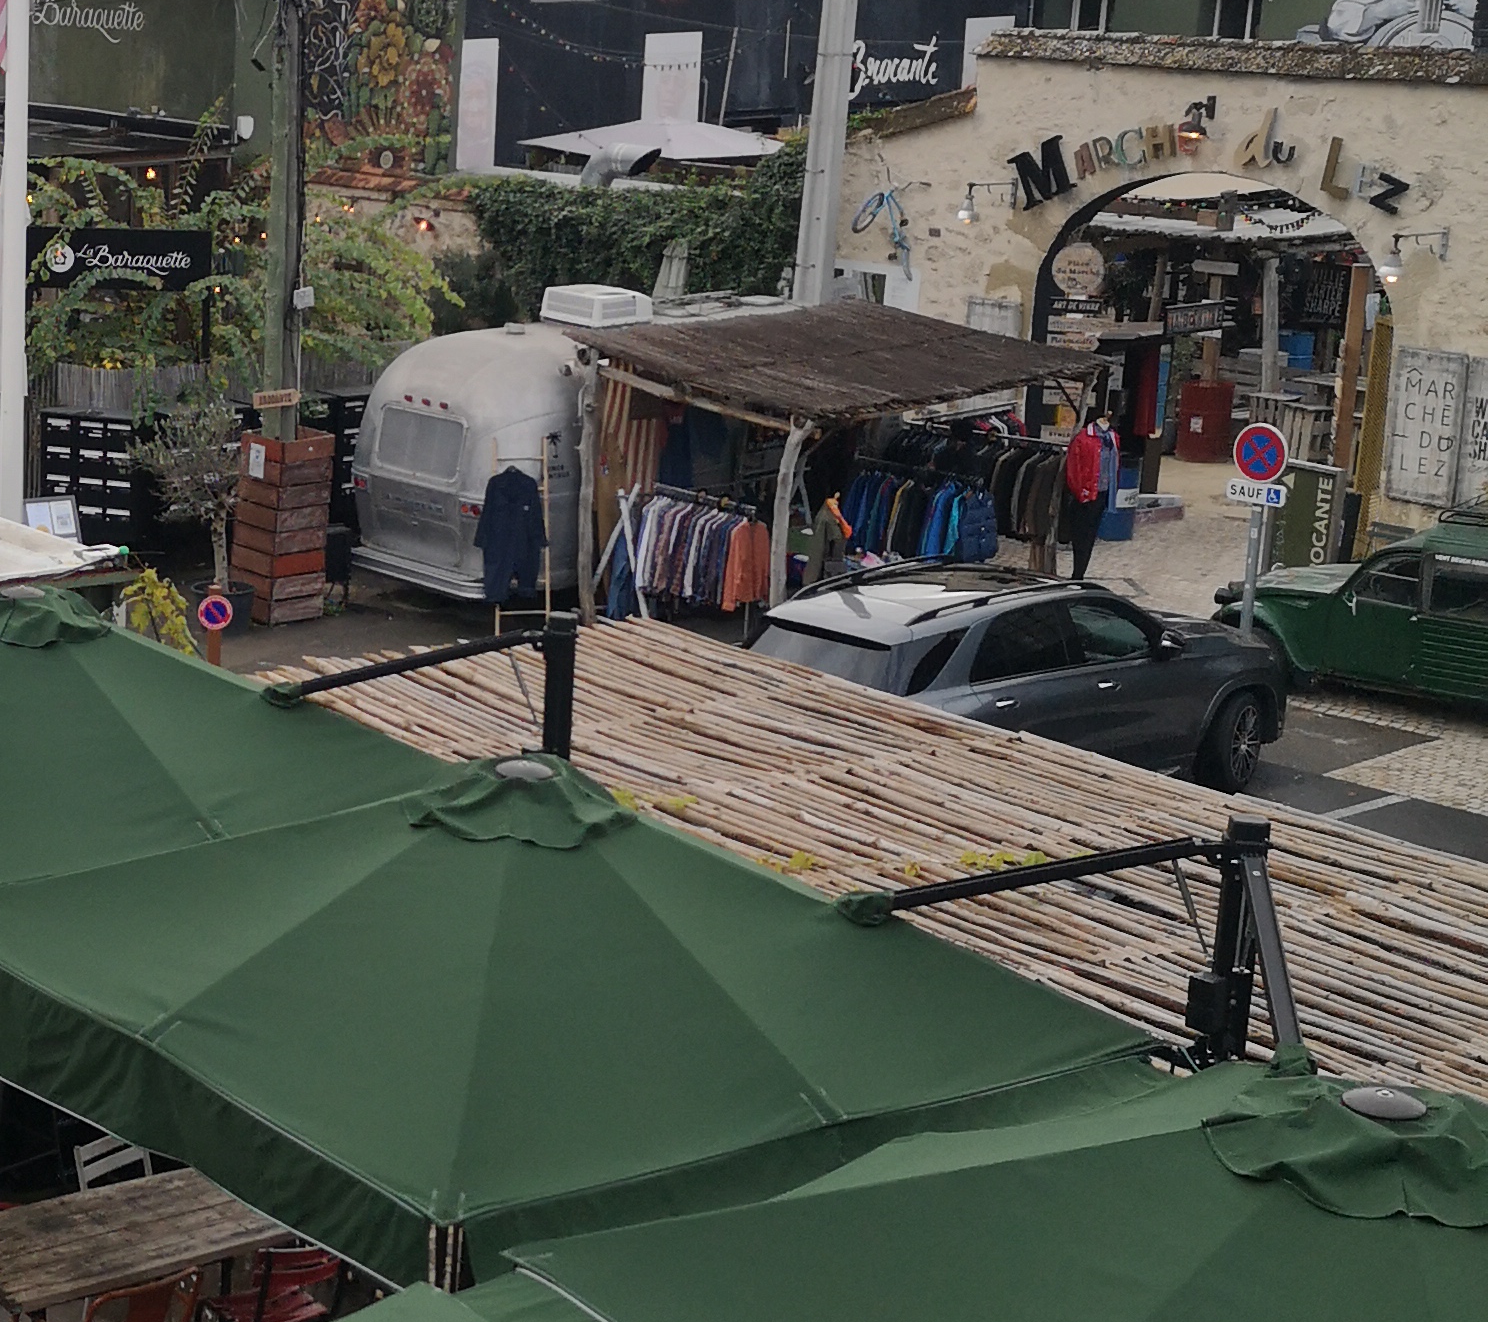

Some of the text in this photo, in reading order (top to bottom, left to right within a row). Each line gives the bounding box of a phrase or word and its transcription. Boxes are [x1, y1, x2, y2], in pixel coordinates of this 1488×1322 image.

[1233, 107, 1296, 169] du
[86, 244, 192, 276] Baraquette
[1304, 297, 1342, 316] SHARPE
[1400, 453, 1447, 478] LEZ
[1230, 484, 1263, 499] SAUF
[1309, 476, 1333, 568] OCANTE
